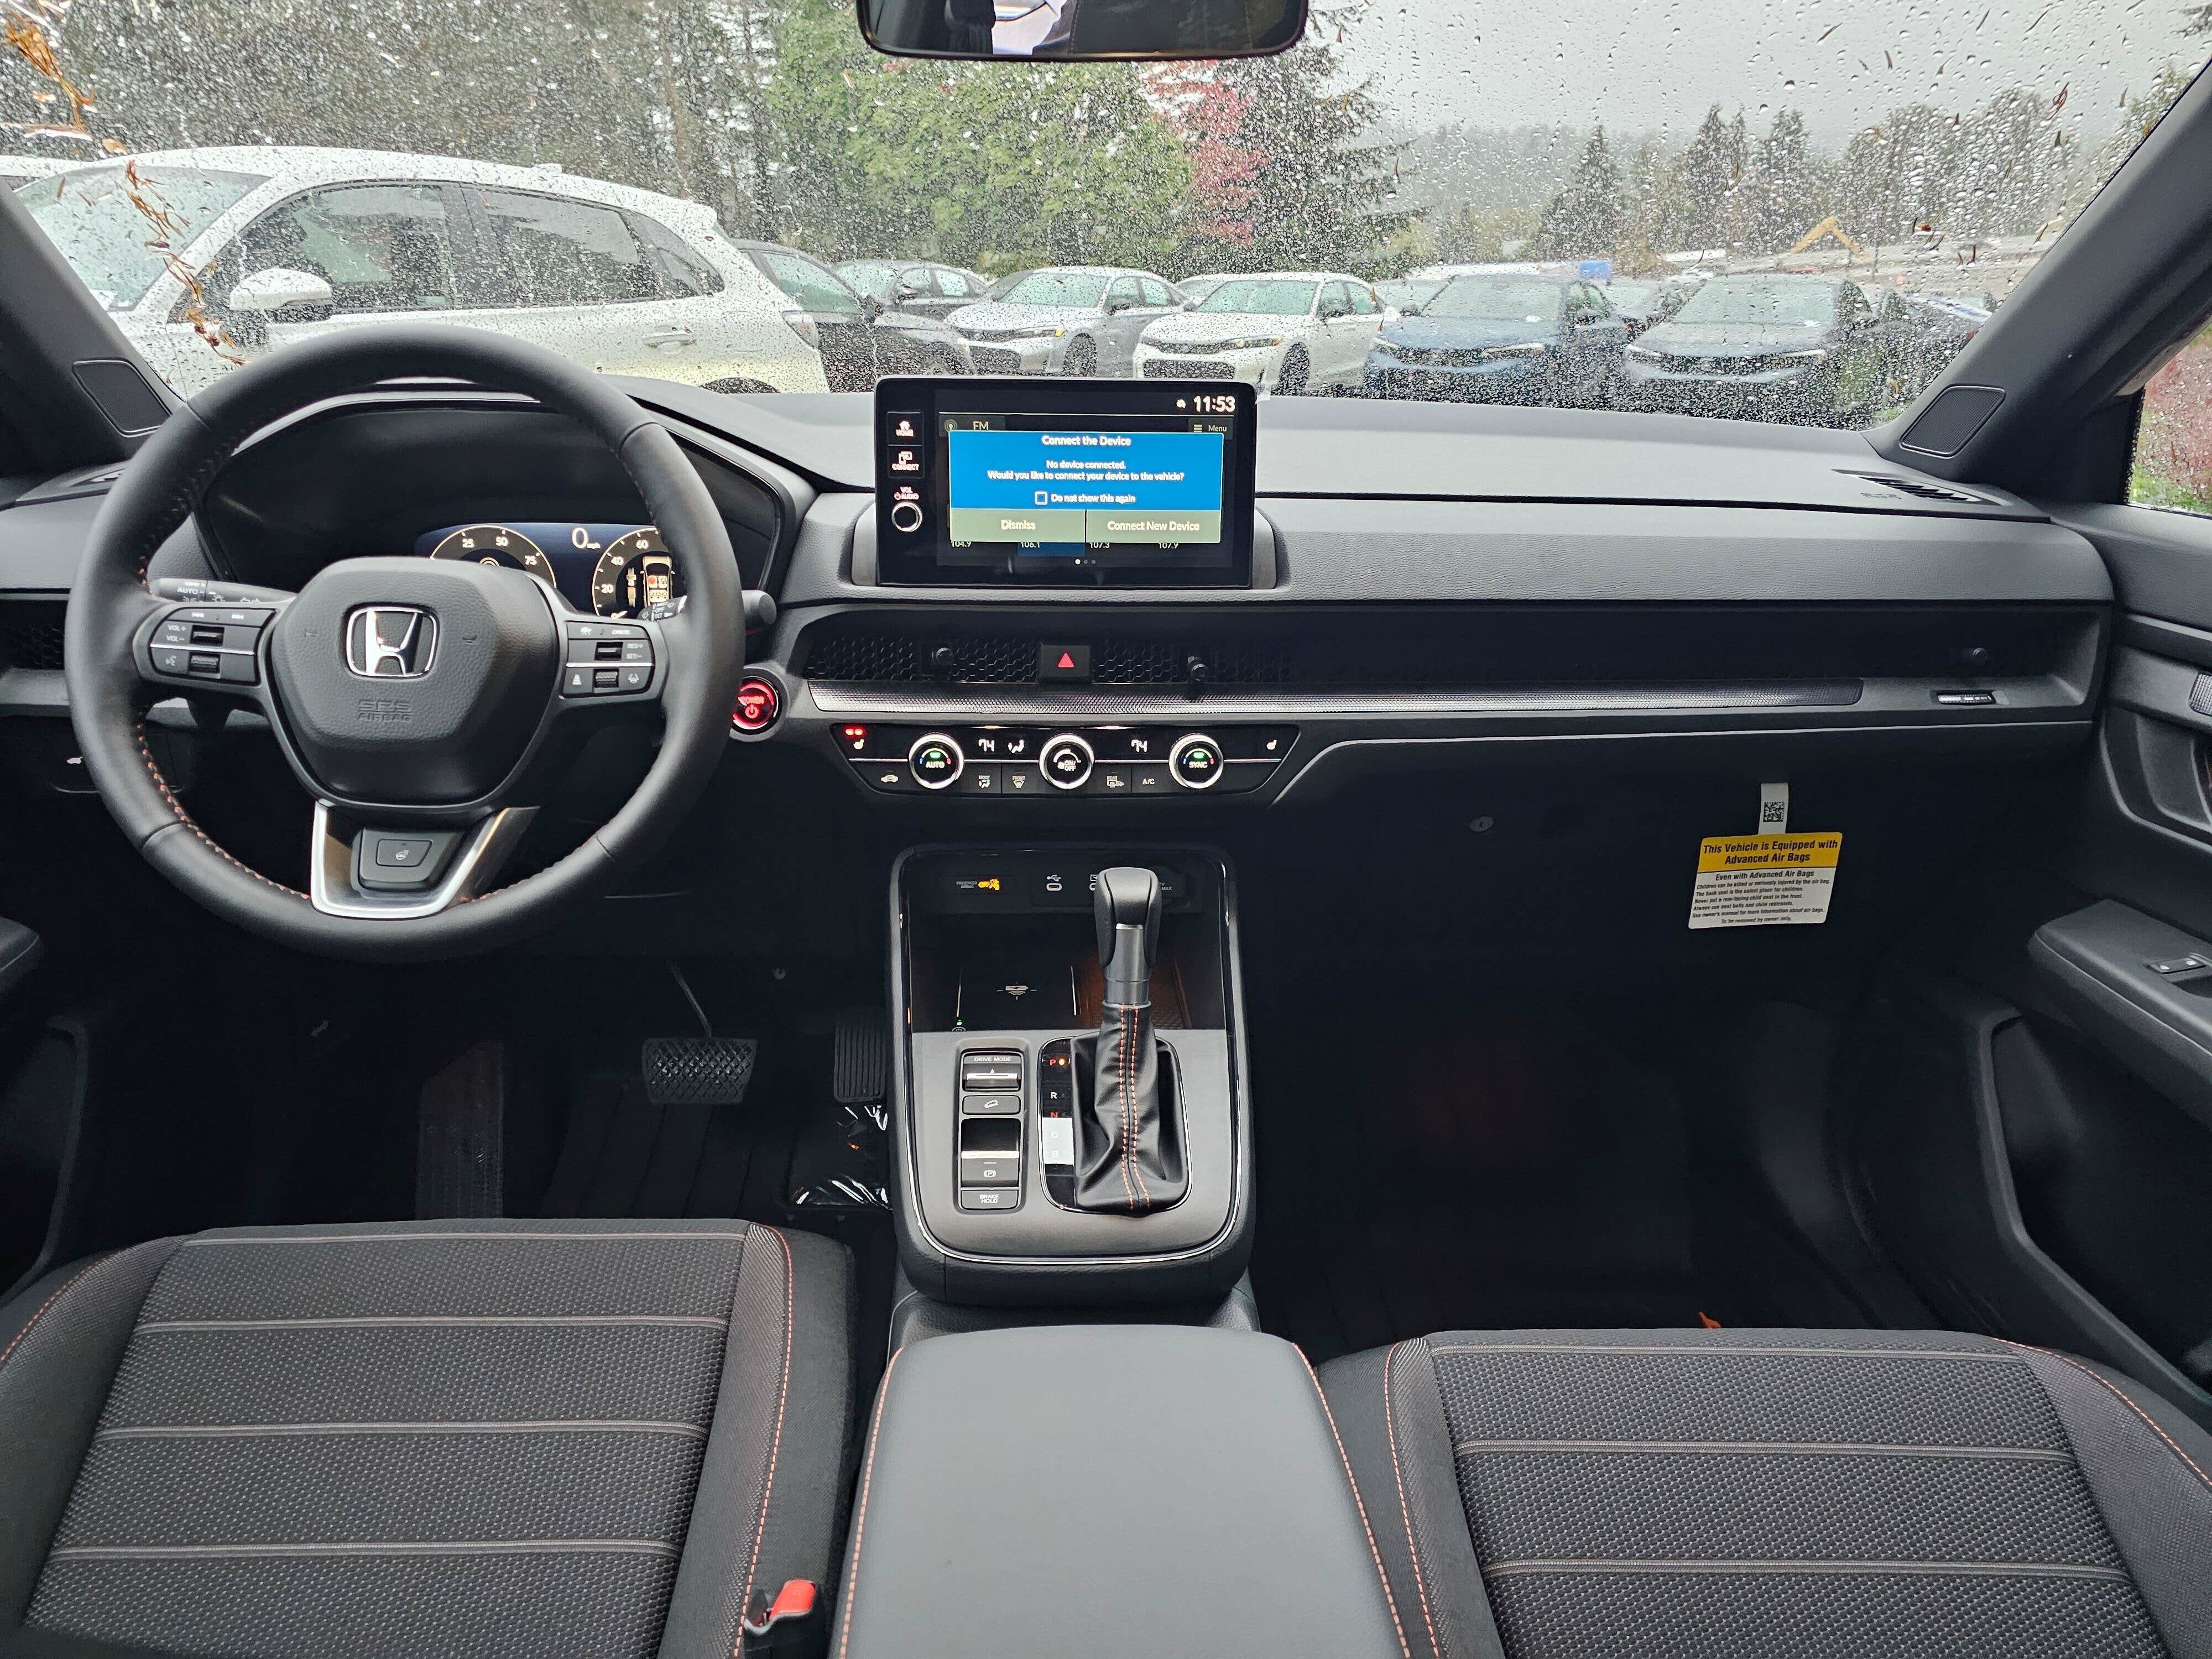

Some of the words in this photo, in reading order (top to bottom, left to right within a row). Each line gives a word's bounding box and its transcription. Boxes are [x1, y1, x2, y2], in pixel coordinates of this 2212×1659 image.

[1193, 395, 1235, 412] 11:53
[973, 421, 989, 430] FM
[1042, 435, 1081, 445] Connect
[1082, 436, 1098, 446] the
[1099, 436, 1131, 446] Device
[1046, 460, 1058, 469] No
[1059, 460, 1084, 469] device
[1084, 461, 1126, 469] connected.
[987, 471, 1014, 480] Would
[1014, 472, 1030, 481] you
[1030, 471, 1045, 480] like
[1045, 472, 1053, 481] to
[1055, 472, 1086, 481] connect
[1086, 473, 1104, 482] your
[1105, 472, 1130, 481] device
[1130, 472, 1139, 481] to
[1140, 472, 1154, 481] the
[1154, 472, 1185, 482] vehicle?
[1051, 493, 1062, 502] Do
[1063, 494, 1078, 503] not
[1078, 494, 1099, 503] show
[1099, 494, 1114, 503] this
[1115, 494, 1136, 504] again
[1000, 520, 1036, 530] Dismiss
[1107, 520, 1145, 531] Connect
[1146, 521, 1168, 531] New
[1169, 521, 1200, 531] Device
[462, 538, 475, 548] 25
[495, 536, 509, 546] 50
[572, 528, 588, 549] 0
[636, 540, 649, 549] 60
[524, 556, 538, 565] 75
[611, 556, 624, 566] 40
[601, 584, 614, 593] 20
[978, 739, 995, 752] 74
[1131, 739, 1147, 753] 74
[1704, 844, 1722, 854] This
[1725, 842, 1758, 852] Vehicle
[1761, 841, 1769, 850] is
[1772, 841, 1815, 851] Equipped
[1818, 840, 1838, 848] with
[1725, 854, 1769, 864] Advanced
[1771, 853, 1785, 862] Air
[1787, 853, 1811, 863] Bags
